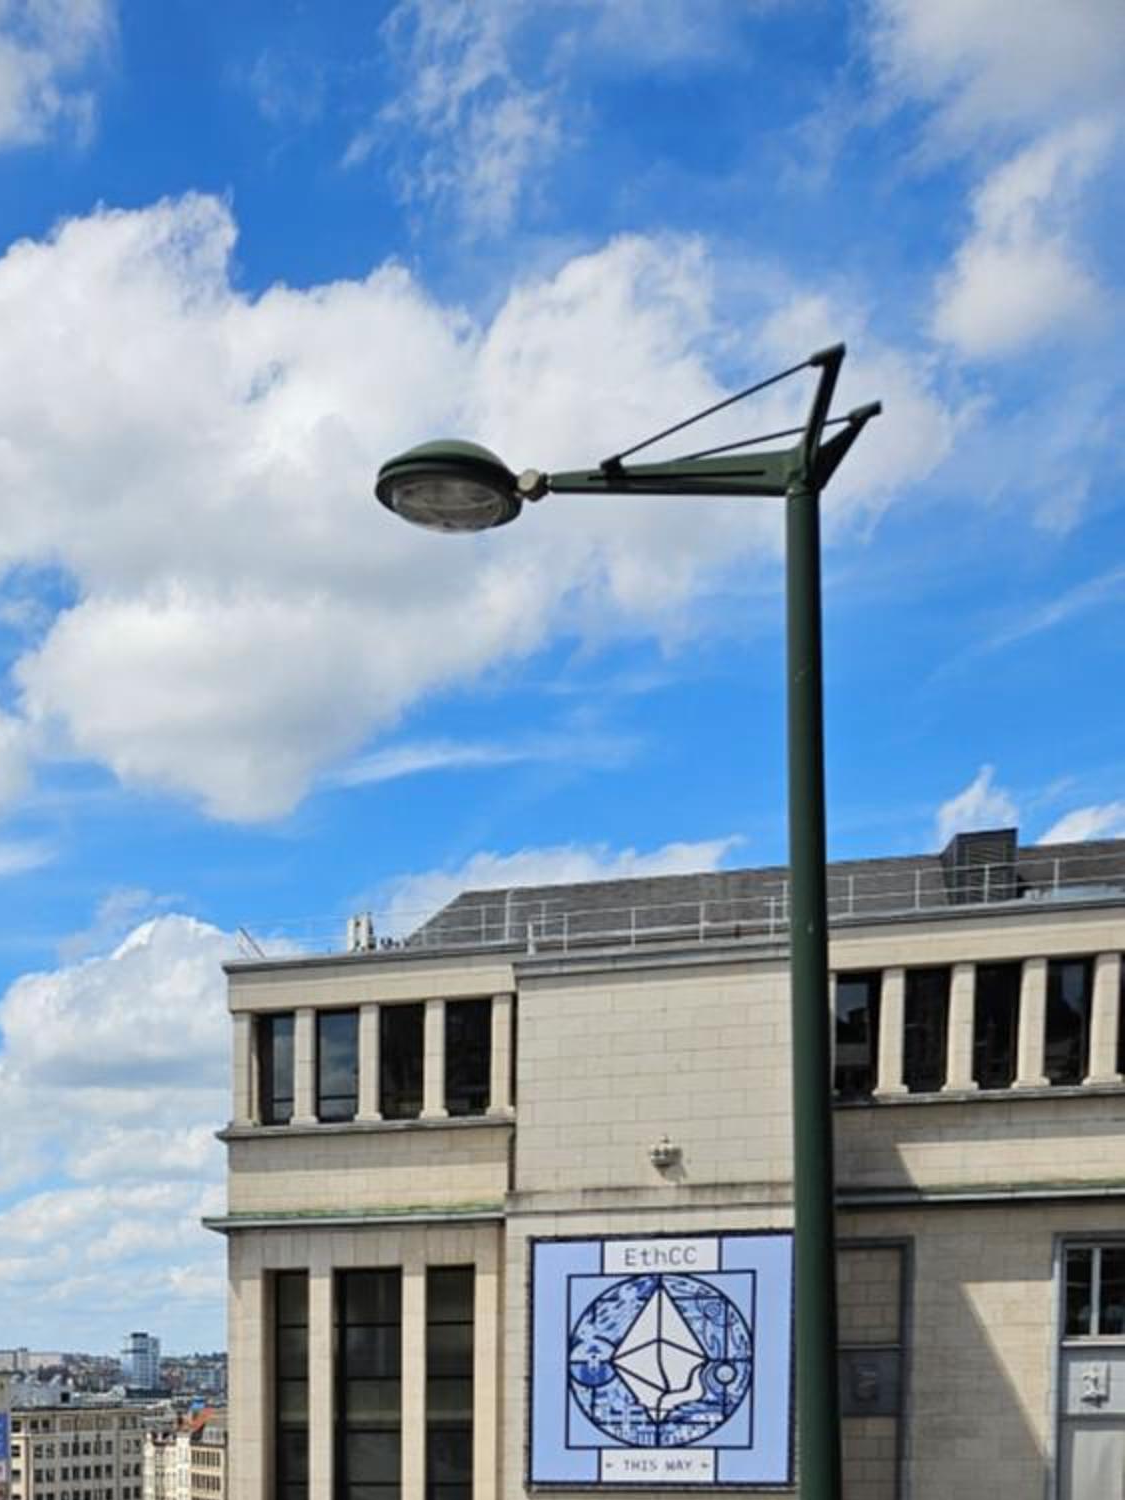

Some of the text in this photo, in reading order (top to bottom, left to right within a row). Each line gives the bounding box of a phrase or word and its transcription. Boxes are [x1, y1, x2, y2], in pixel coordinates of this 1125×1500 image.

[623, 1246, 698, 1268] EthCC
[623, 1457, 692, 1472] THIS WAY
